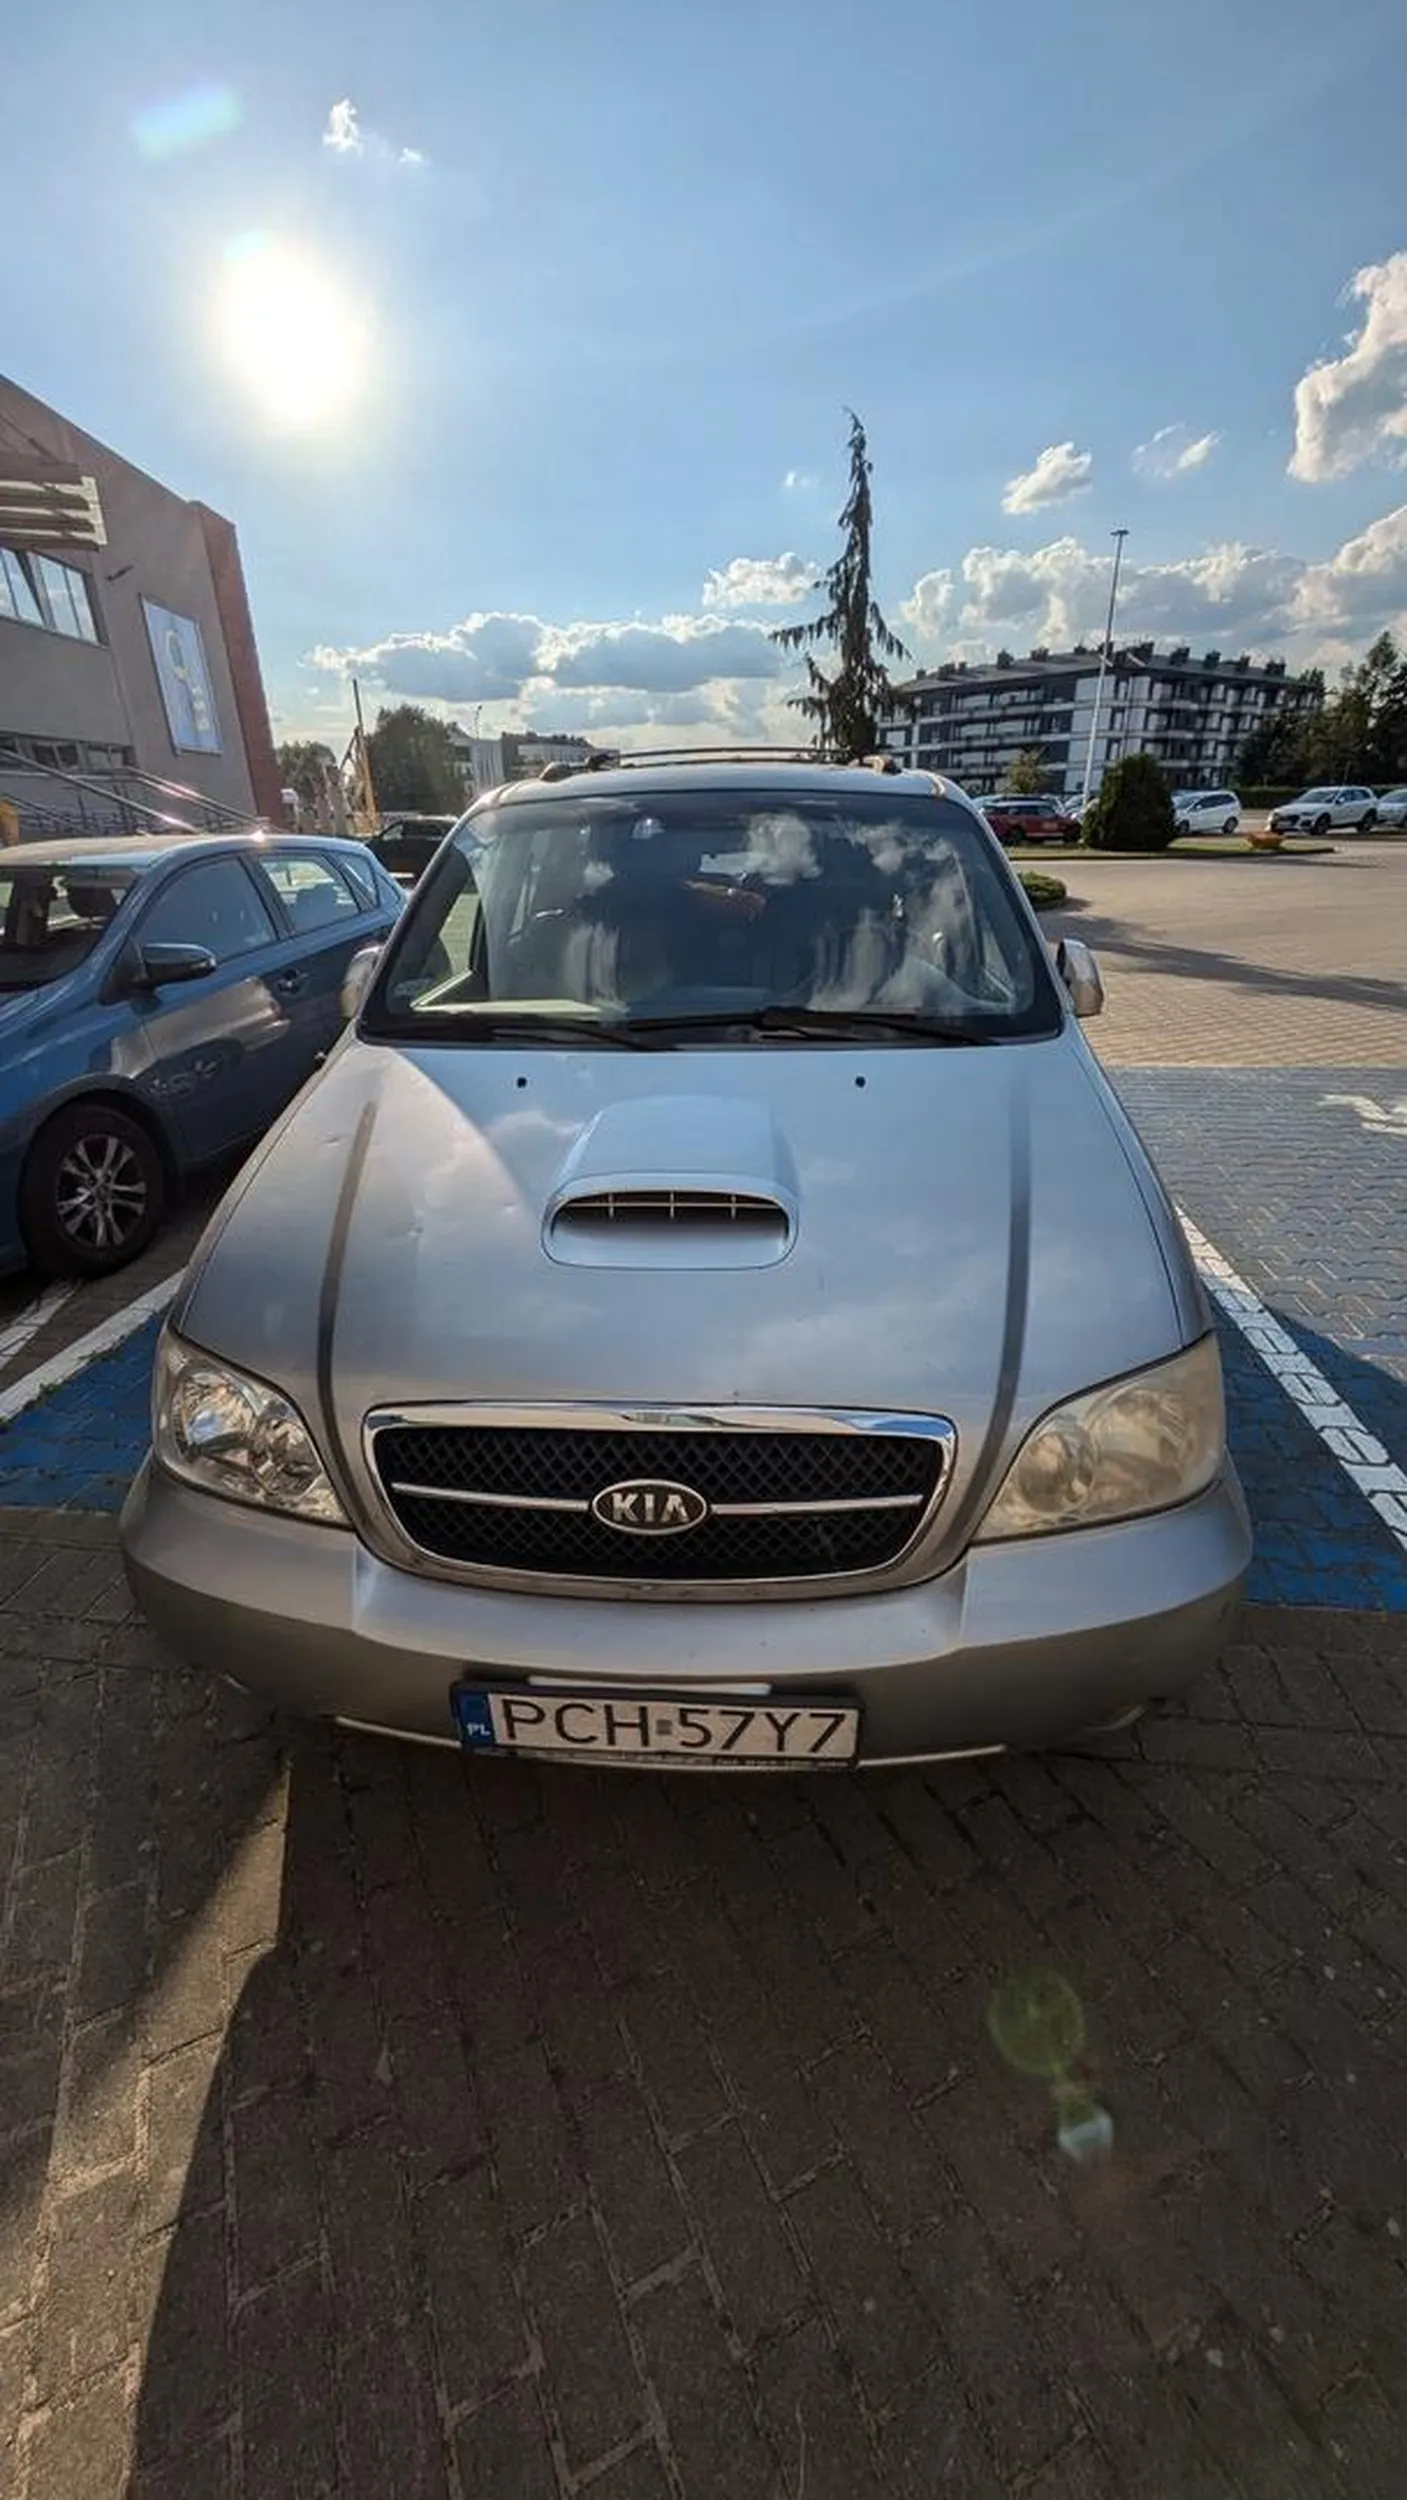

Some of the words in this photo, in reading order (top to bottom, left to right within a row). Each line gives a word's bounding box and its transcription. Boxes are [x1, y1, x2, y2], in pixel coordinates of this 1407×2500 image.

[612, 1492, 690, 1522] KIA
[467, 1722, 491, 1736] PL
[502, 1699, 650, 1748] PCH
[677, 1708, 847, 1754] 57Y7
